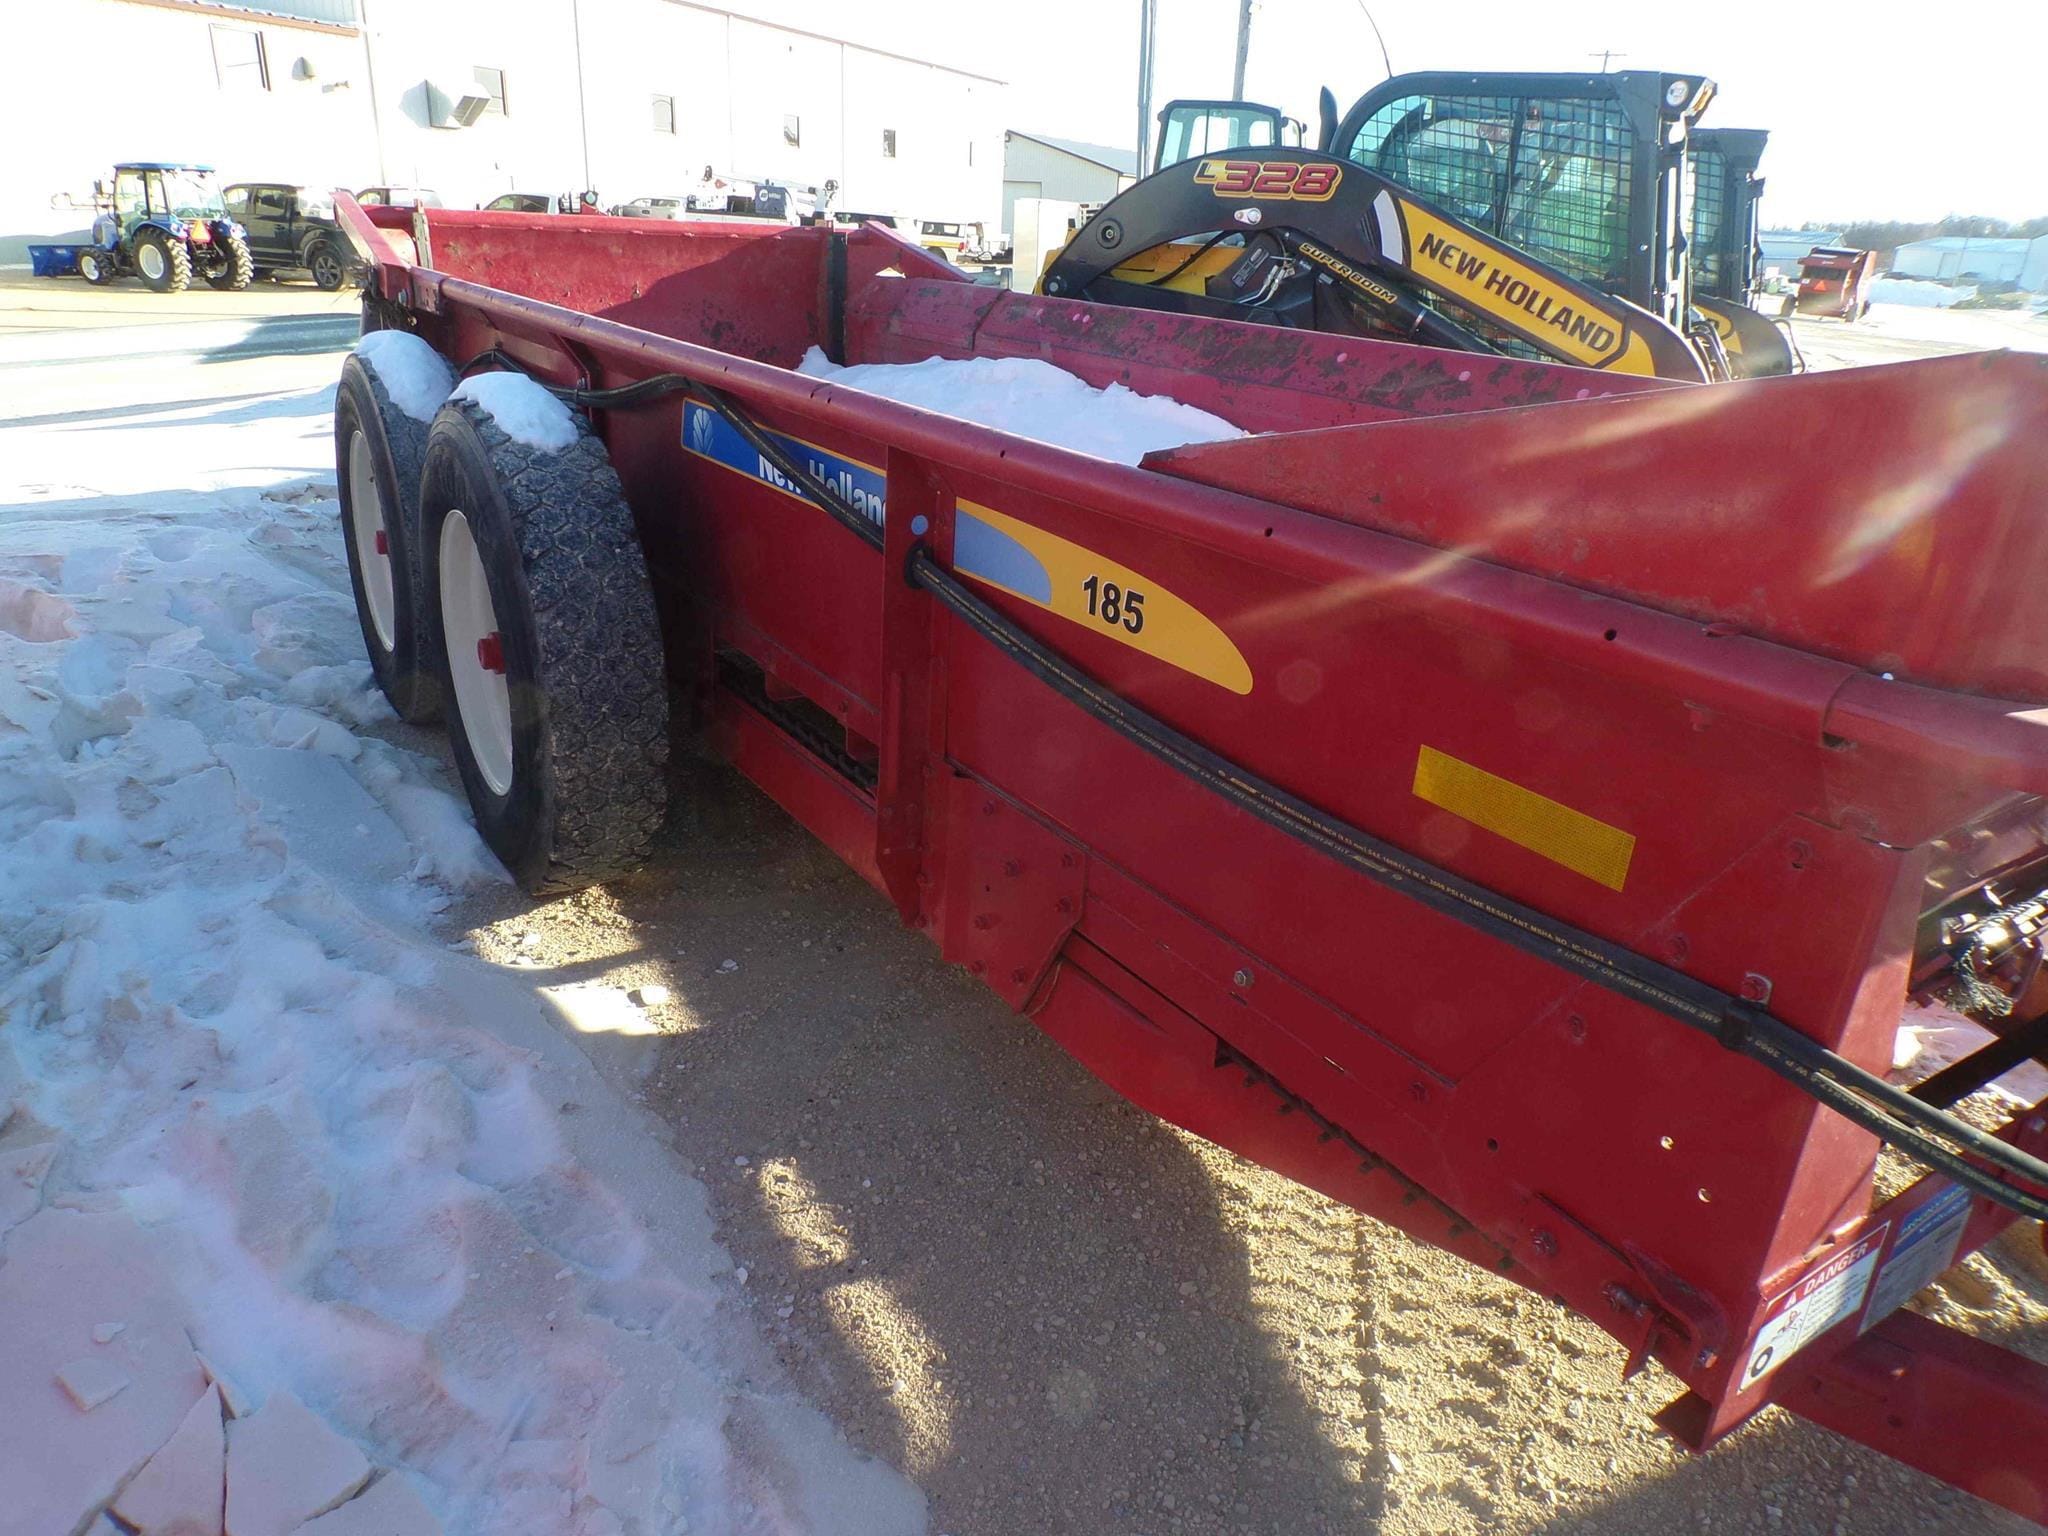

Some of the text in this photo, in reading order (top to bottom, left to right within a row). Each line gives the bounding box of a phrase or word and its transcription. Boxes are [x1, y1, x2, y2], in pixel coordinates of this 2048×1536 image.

[1194, 159, 1343, 202] L328
[1299, 242, 1352, 276] SUPER
[1349, 271, 1398, 305] BOOM
[1418, 231, 1615, 354] NEW HOLLAND
[1081, 575, 1145, 634] 185
[1485, 904, 1529, 928] RESISTANT
[1803, 1242, 1869, 1296] DANGER
